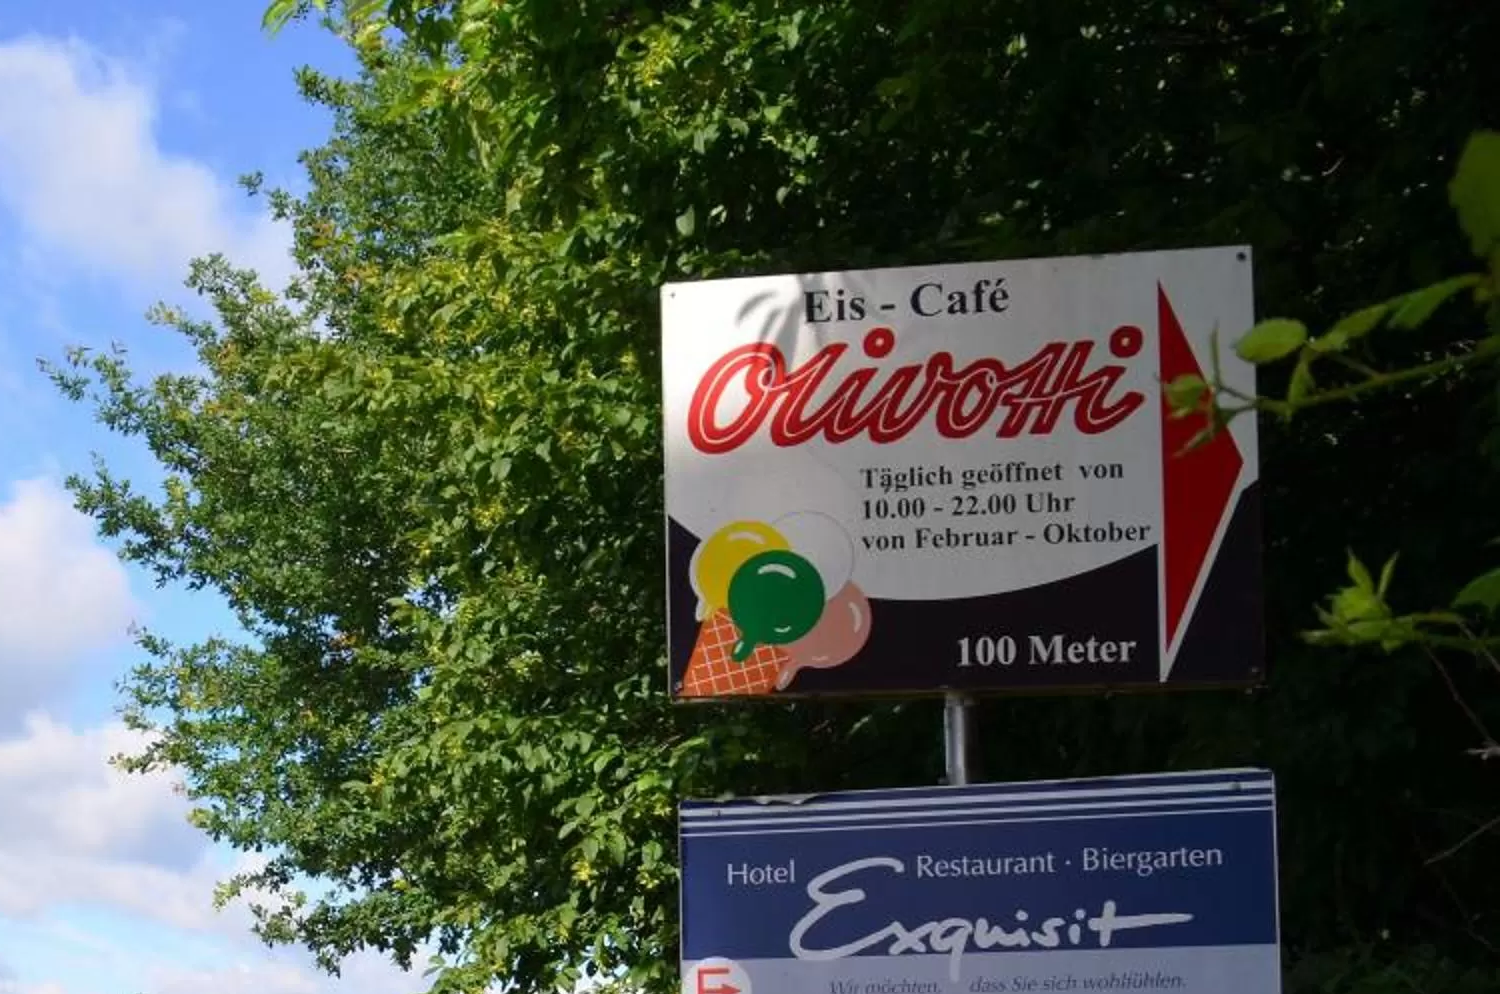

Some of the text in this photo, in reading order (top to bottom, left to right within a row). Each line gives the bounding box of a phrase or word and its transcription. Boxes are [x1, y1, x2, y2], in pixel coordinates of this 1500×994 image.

[804, 289, 866, 322] Eis
[910, 278, 1010, 317] Café
[687, 325, 1146, 454] Olivotti
[860, 461, 1124, 492] Täglich geöffnet von
[862, 497, 926, 520] 10.00
[952, 493, 1017, 517] 22.00
[1026, 492, 1076, 514] Uhr
[862, 534, 905, 551] von
[915, 527, 1018, 550] Februar
[1043, 521, 1151, 545] Oktober
[957, 634, 1137, 668] 100 Meter
[727, 847, 1224, 885] Hotel Restaurant Biergarten
[790, 857, 1193, 982] Exquisit
[969, 976, 1006, 993] dass
[1011, 976, 1038, 992] Sie
[1043, 974, 1077, 991] sich
